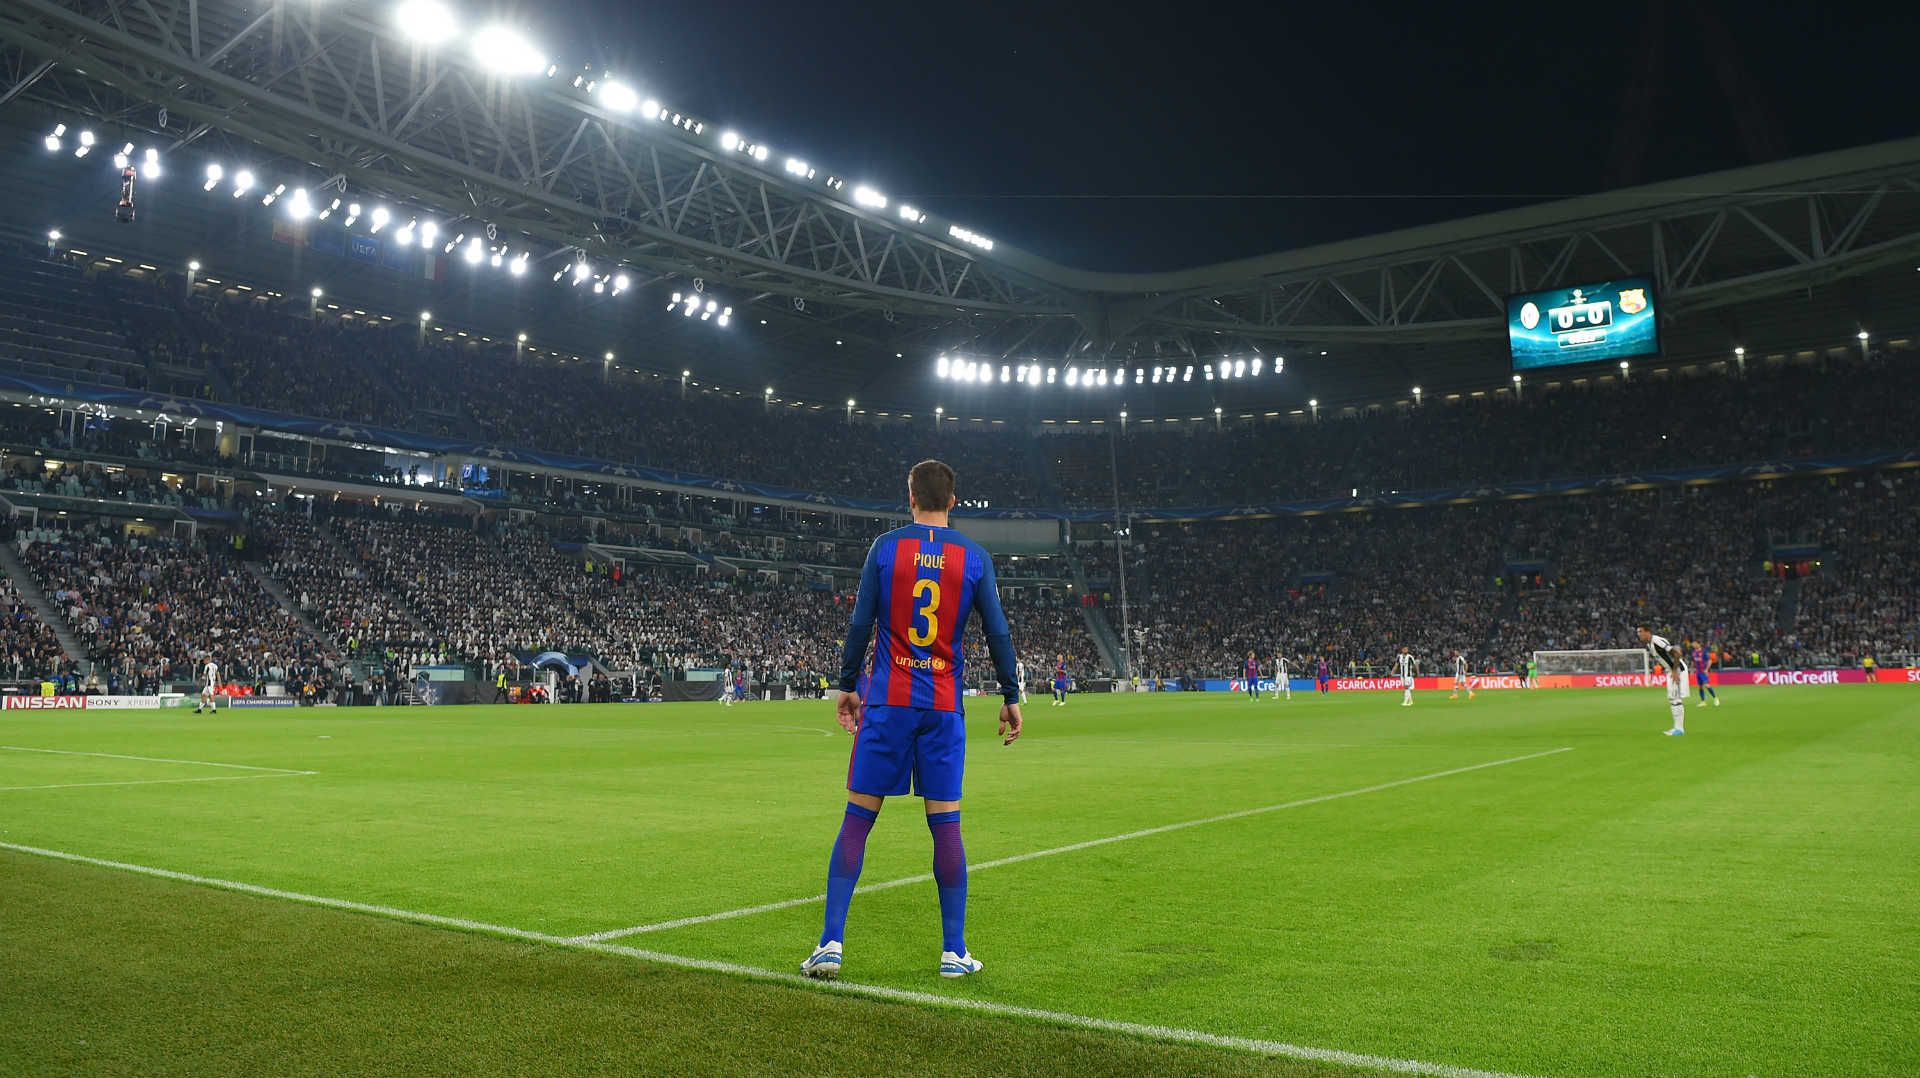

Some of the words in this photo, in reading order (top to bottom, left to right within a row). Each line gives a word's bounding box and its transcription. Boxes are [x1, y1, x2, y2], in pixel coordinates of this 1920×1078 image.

[913, 552, 946, 570] PIQUÉ
[907, 578, 941, 647] 3
[895, 655, 932, 669] unicef
[1337, 680, 1375, 690] SCARICA
[1768, 671, 1839, 685] UniCredit
[11, 697, 83, 708] NISSAN
